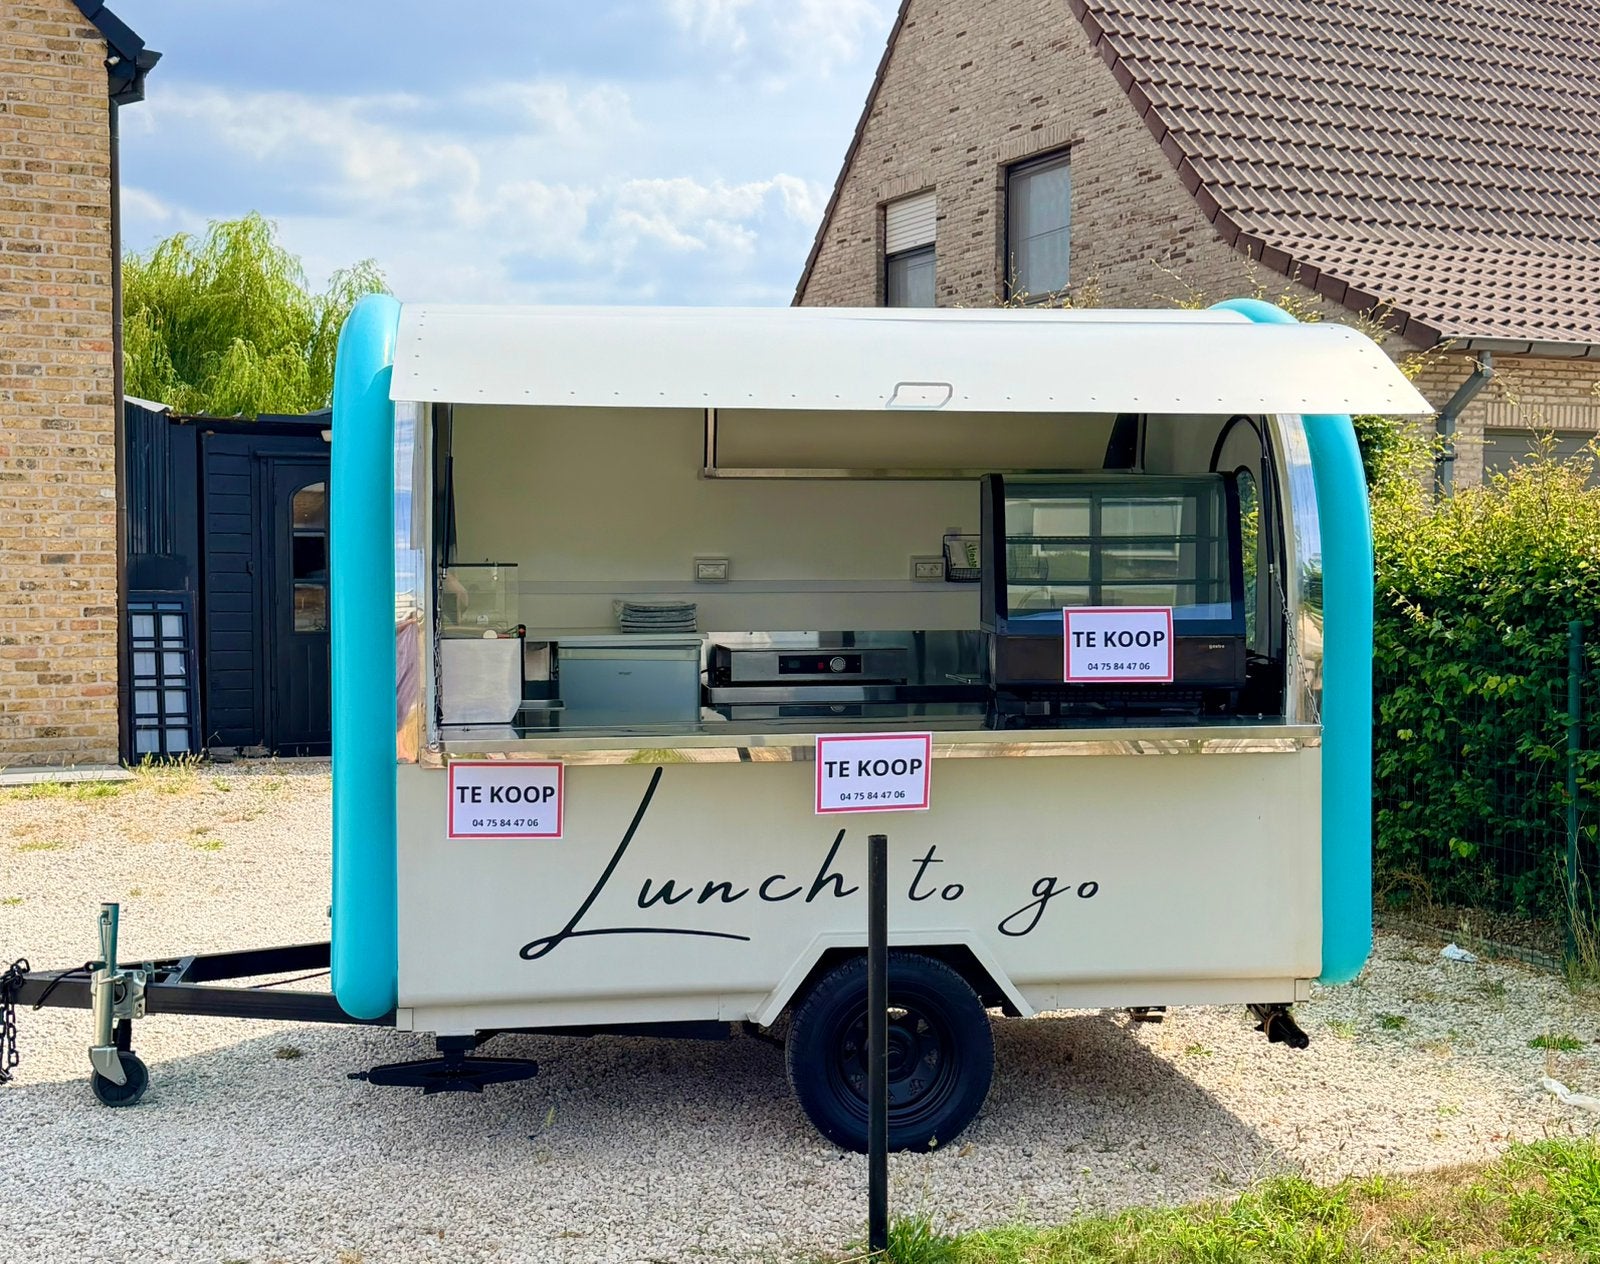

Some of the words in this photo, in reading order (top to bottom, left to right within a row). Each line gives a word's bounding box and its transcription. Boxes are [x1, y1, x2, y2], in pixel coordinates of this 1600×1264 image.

[1072, 631, 1097, 648] TE
[1103, 630, 1165, 648] KOOP
[1087, 662, 1099, 671] 04
[1100, 662, 1112, 671] 75
[1113, 662, 1125, 671] 84
[1126, 662, 1138, 671] 47
[1138, 662, 1151, 671] 06
[824, 761, 850, 779] TE
[857, 758, 923, 777] KOOP
[456, 785, 482, 804] TE
[489, 785, 556, 804] KOOP
[839, 792, 852, 801] 04
[853, 791, 865, 801] 75
[866, 791, 879, 800] 84
[880, 791, 892, 799] 47
[893, 790, 906, 799] 06
[471, 818, 484, 828] 04
[486, 818, 498, 828] 75
[499, 818, 512, 828] 84
[513, 818, 526, 828] 47
[526, 818, 539, 828] 06
[519, 767, 859, 960] Lunch
[909, 845, 965, 901] to
[998, 876, 1098, 936] go
